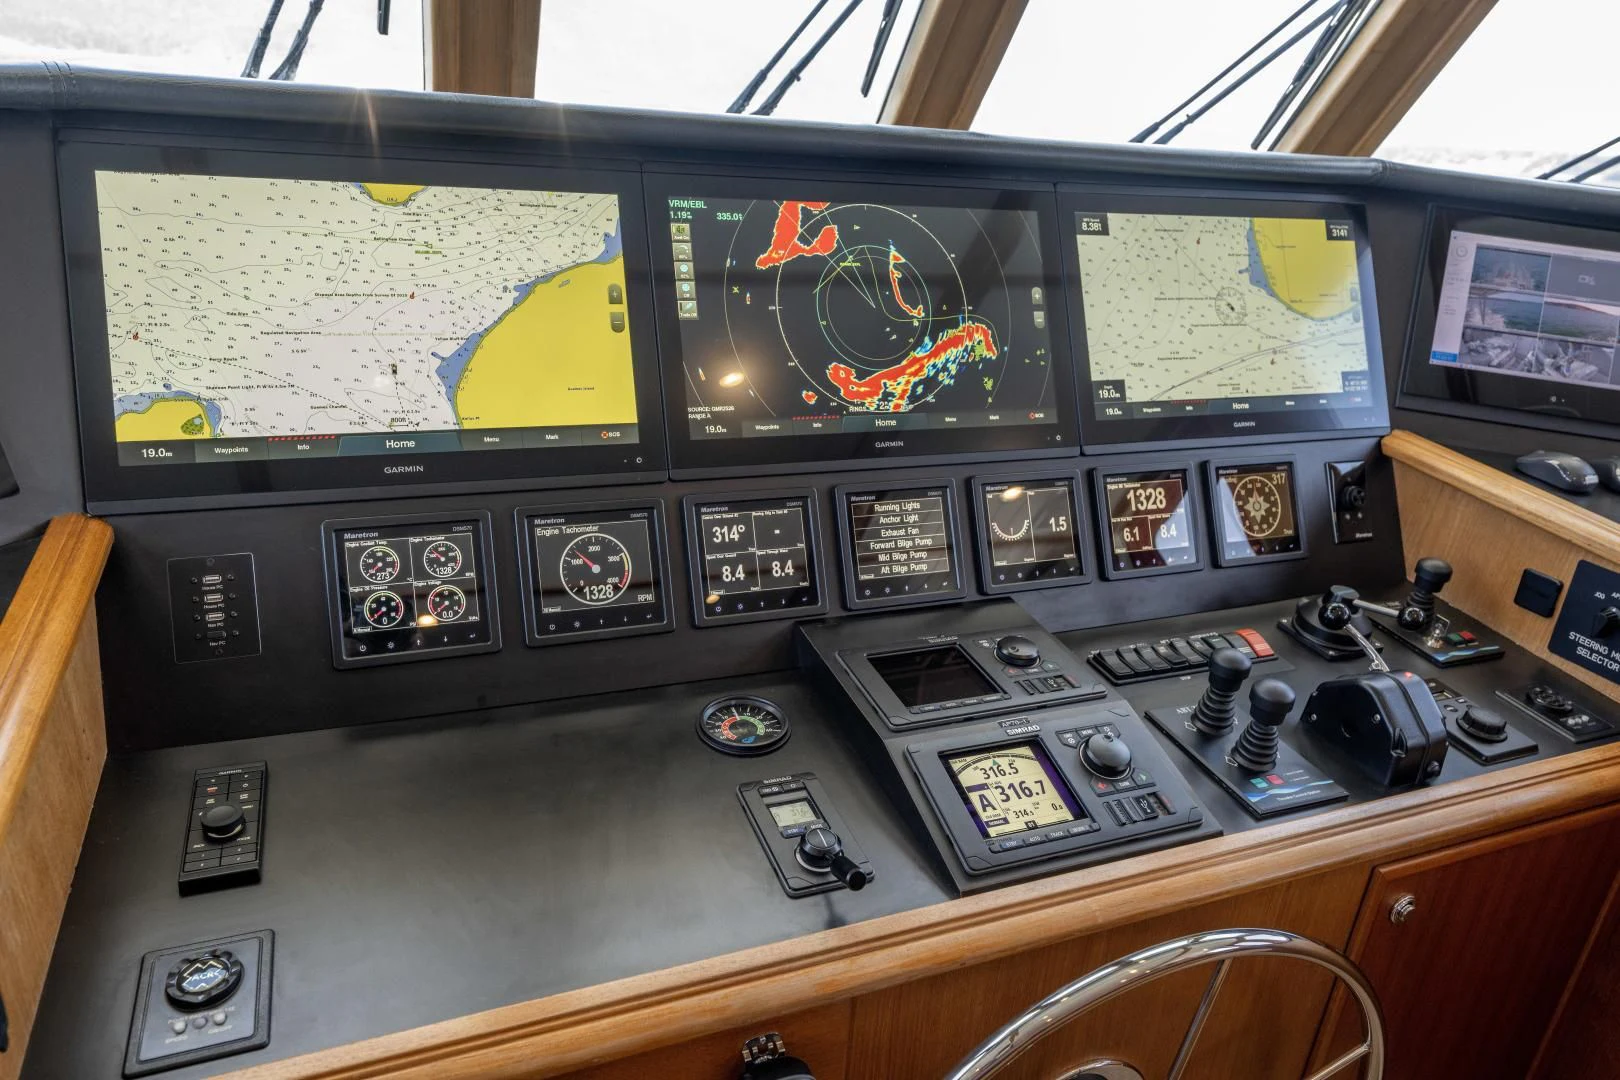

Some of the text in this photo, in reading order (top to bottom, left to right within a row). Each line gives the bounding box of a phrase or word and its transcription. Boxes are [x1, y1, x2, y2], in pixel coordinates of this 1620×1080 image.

[669, 199, 707, 208] VRM/EBL
[1232, 402, 1249, 410] Home
[875, 419, 897, 427] Home
[386, 440, 415, 448] Home
[142, 448, 173, 458] 19.0m
[215, 446, 249, 454] Waypoints
[384, 465, 424, 474] GARMIN
[1272, 473, 1286, 485] 317
[1127, 487, 1166, 512] 1328
[875, 502, 920, 512] Running Lights
[880, 514, 919, 524] Anchor Light
[1050, 516, 1067, 532] 1.5
[344, 532, 378, 540] Maretron
[536, 525, 600, 536] Engine Tachometer
[712, 524, 745, 543] 314°
[881, 528, 906, 537] Exhaust
[1123, 526, 1140, 542] 6.1
[1160, 524, 1177, 538] 8.4
[870, 538, 932, 550] Forward Bilge Pump
[878, 551, 927, 562] Mid Bilge Pump
[436, 567, 452, 575] 1328
[722, 564, 745, 582] 8.4
[772, 560, 794, 577] 8.4
[881, 563, 928, 574] Aft Bilge Pump
[583, 584, 614, 601] 1328
[638, 594, 652, 602] RPM
[442, 610, 453, 618] 0.0
[1569, 631, 1608, 655] STEERING
[1576, 646, 1620, 672] SELECTOR
[1007, 725, 1040, 735] SIMRAD
[980, 763, 1019, 780] 316.5
[994, 779, 1046, 803] 316.7
[978, 793, 998, 813] A
[192, 971, 214, 980] ACR
